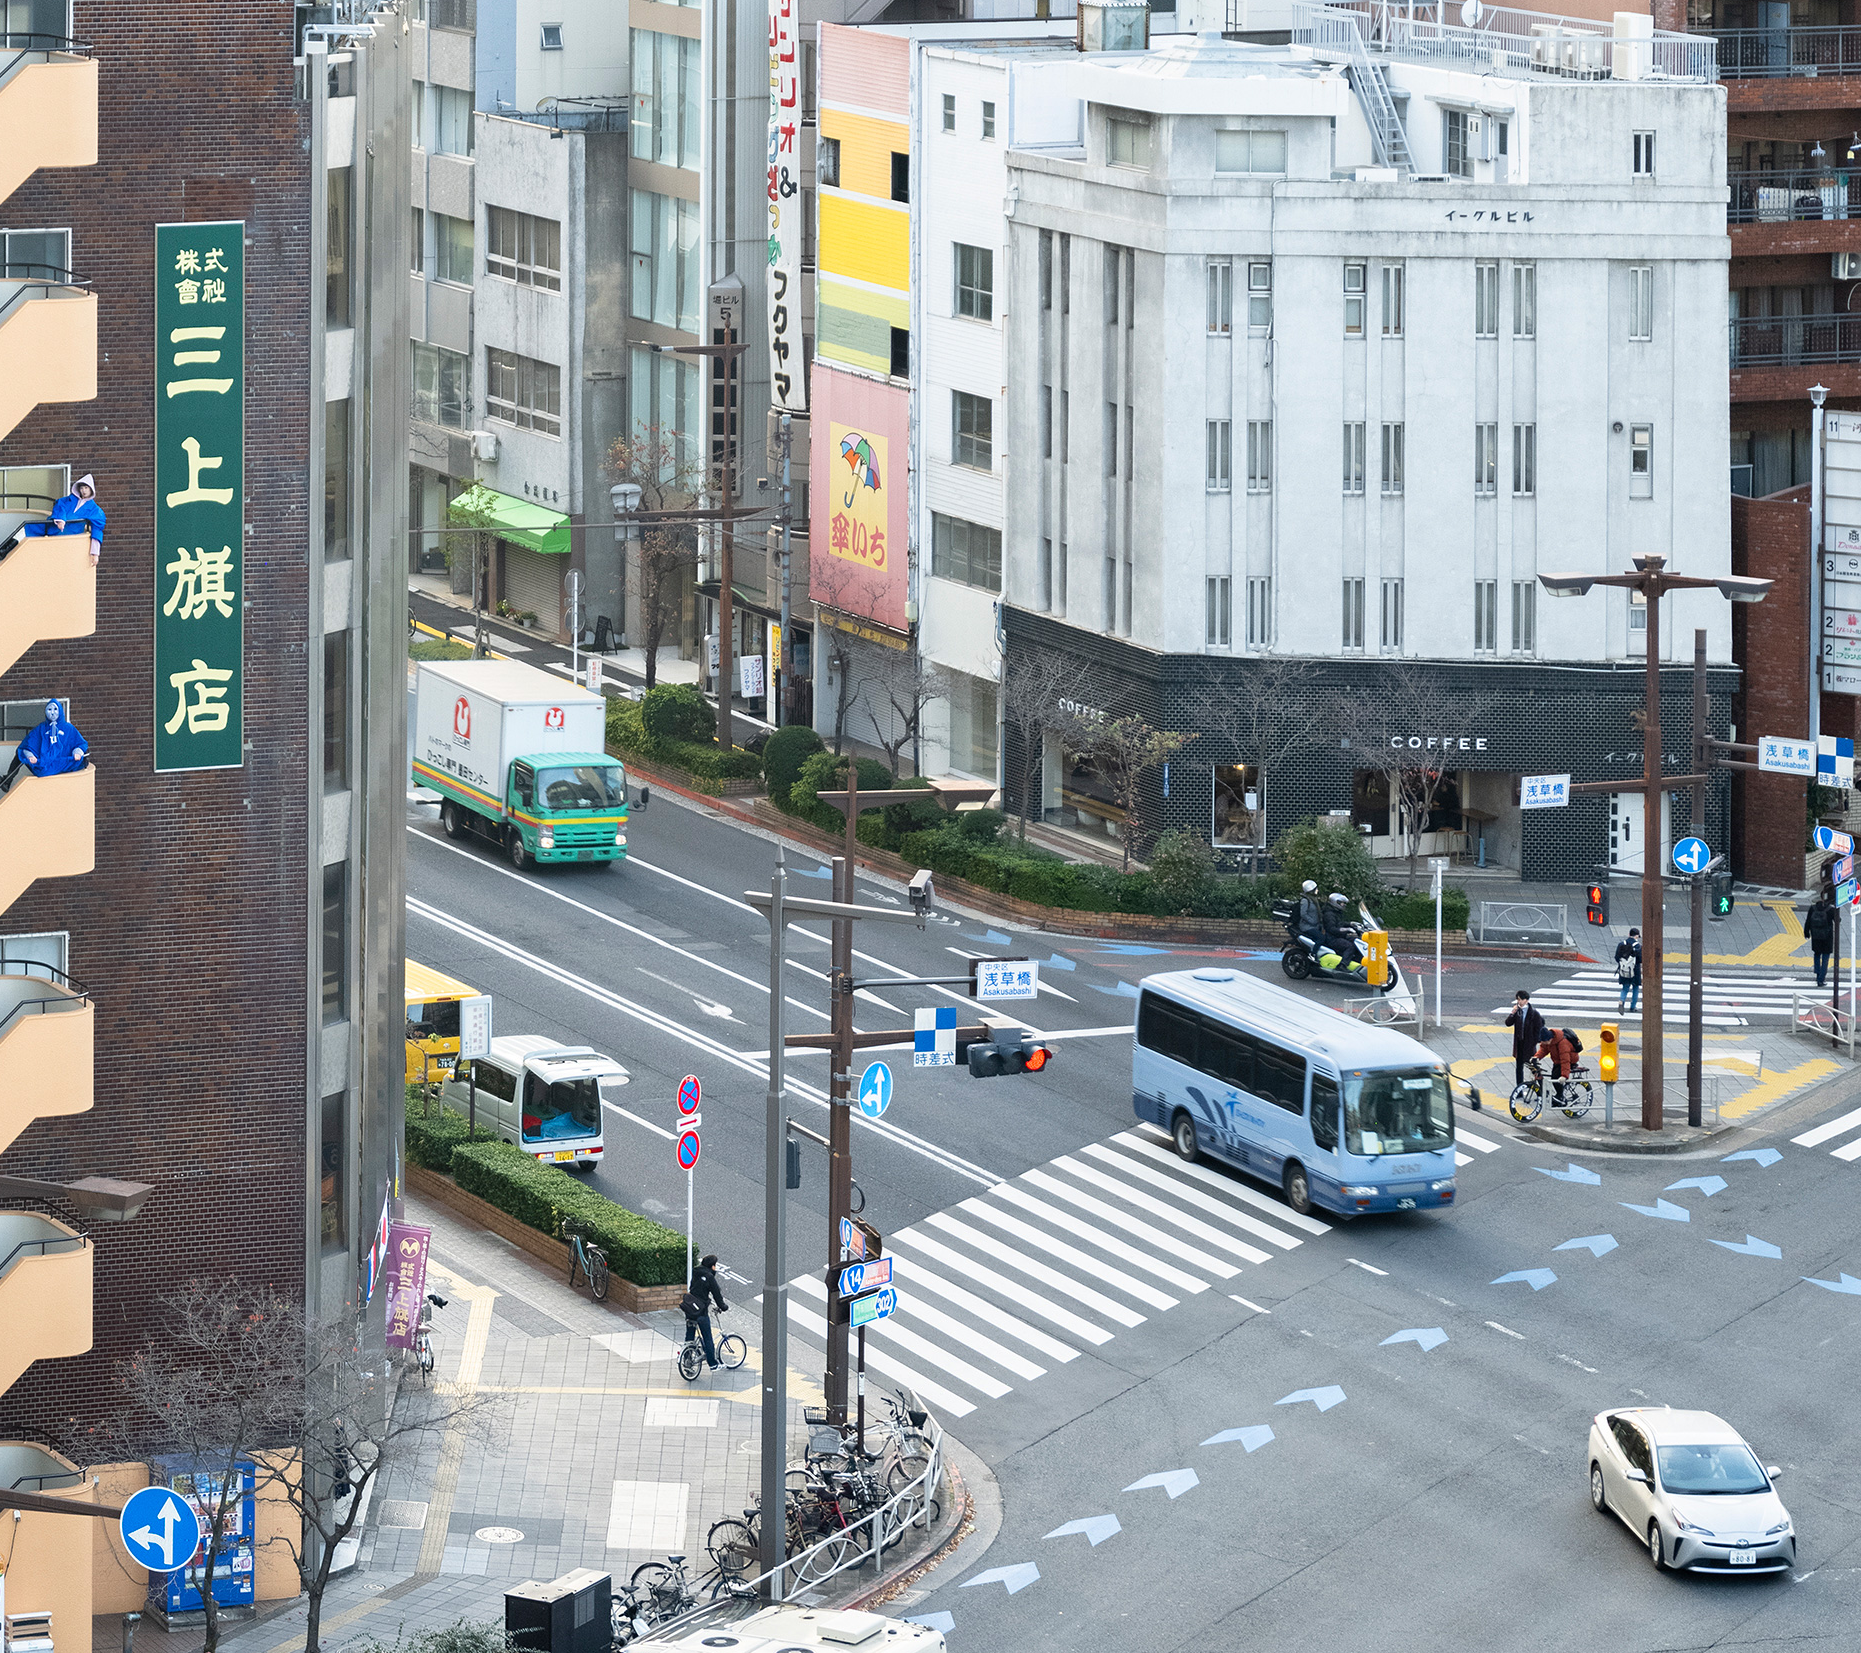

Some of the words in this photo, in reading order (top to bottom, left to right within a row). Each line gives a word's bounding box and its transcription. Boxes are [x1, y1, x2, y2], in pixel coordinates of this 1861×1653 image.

[174, 248, 228, 275] 株式
[720, 307, 732, 320] 5
[773, 269, 792, 405] フクヤマ
[1829, 421, 1838, 433] 11
[163, 325, 235, 736] 三上旗店
[831, 511, 885, 567] 傘いち
[1826, 559, 1834, 573] 3
[1825, 617, 1833, 628] 2
[1825, 645, 1832, 656] 2
[1826, 673, 1832, 686] 1
[1391, 736, 1488, 750] COFFEE
[1765, 744, 1809, 762] 浅草橋
[427, 748, 457, 774] ひっこし専門
[1765, 758, 1810, 771] Asakusabashi
[1818, 773, 1853, 789] 時差式
[1526, 783, 1564, 797] 浅草橋
[1525, 796, 1565, 806] Asakusabashi
[984, 963, 1009, 972] 中央区
[984, 971, 1032, 987] 浅草橋
[983, 987, 1032, 997] Asakusabashi
[915, 1052, 955, 1066] 時差式
[845, 1223, 851, 1239] 6
[849, 1271, 862, 1286] 14
[876, 1297, 891, 1314] 302
